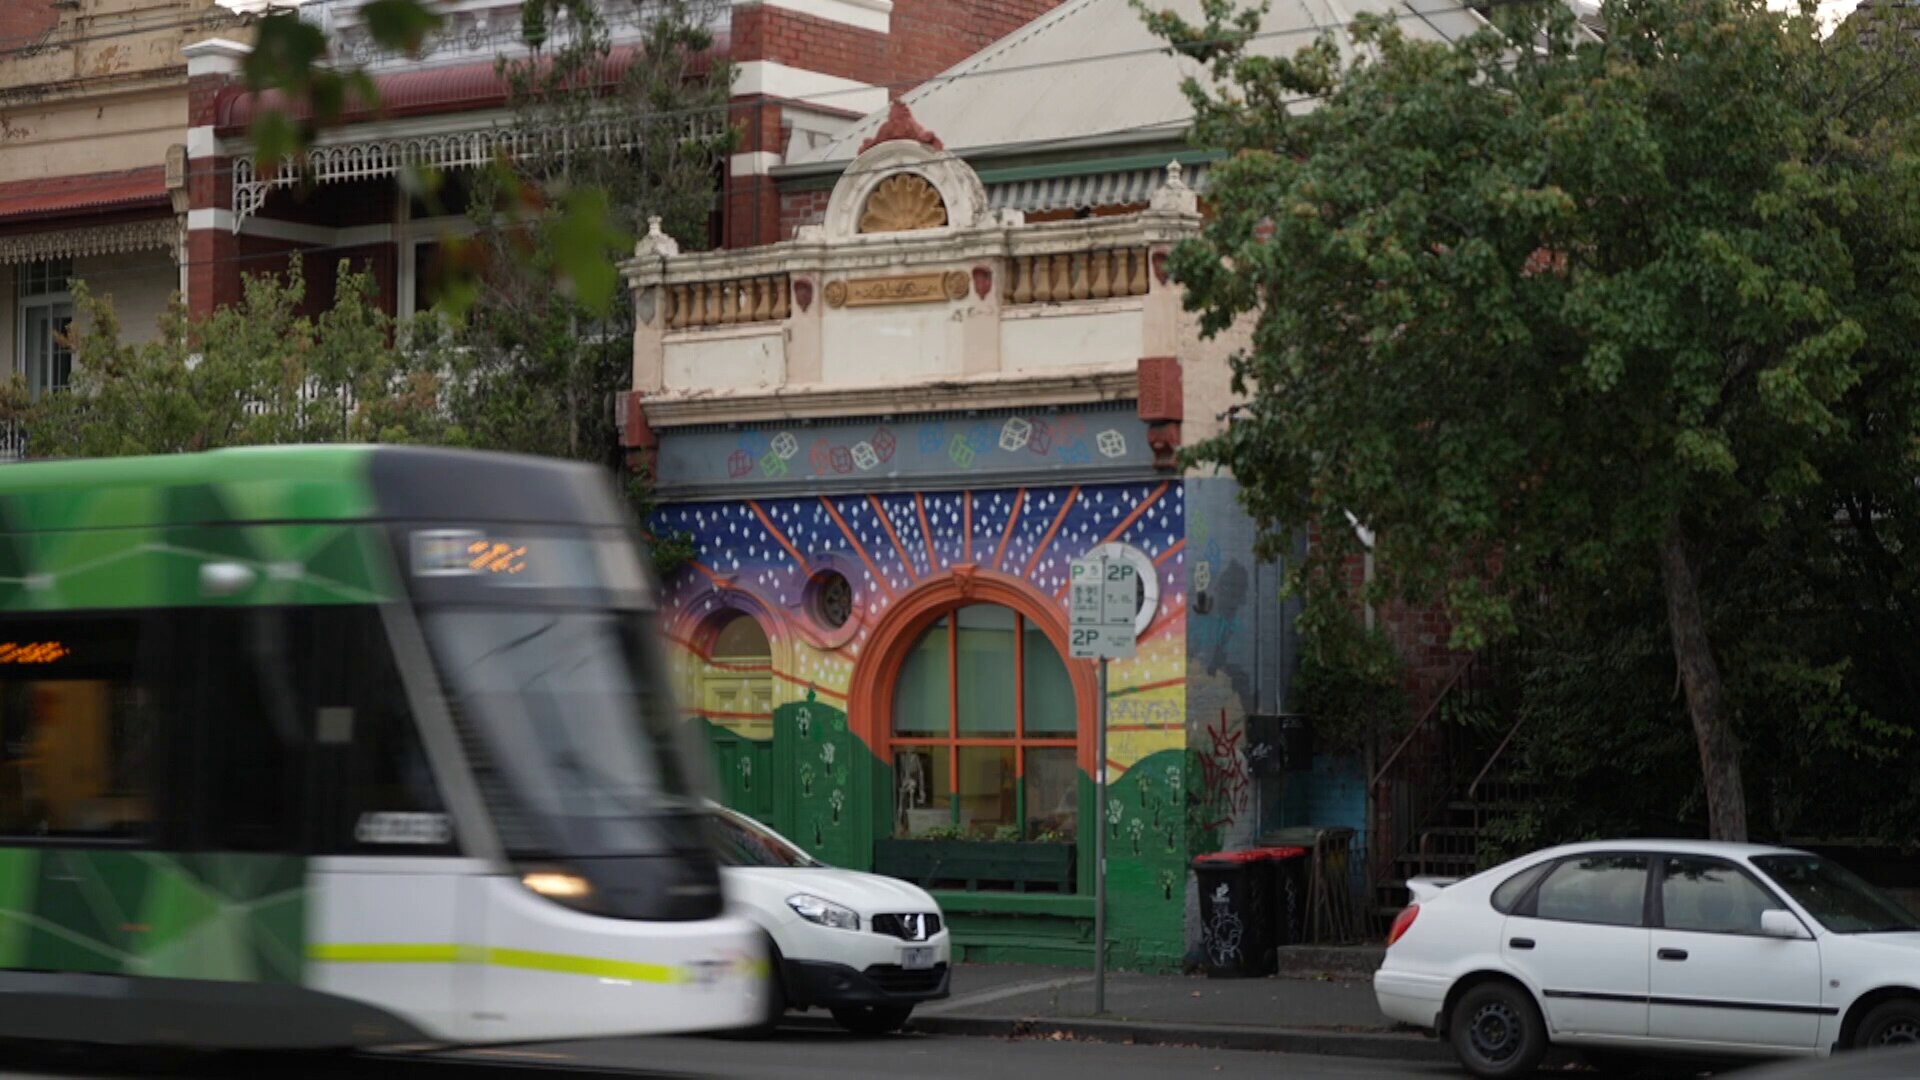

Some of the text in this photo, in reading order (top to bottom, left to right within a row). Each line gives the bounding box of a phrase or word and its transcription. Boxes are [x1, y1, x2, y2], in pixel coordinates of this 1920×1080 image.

[1072, 565, 1084, 580] P
[1107, 564, 1133, 581] 2P
[1072, 629, 1099, 646] 2P
